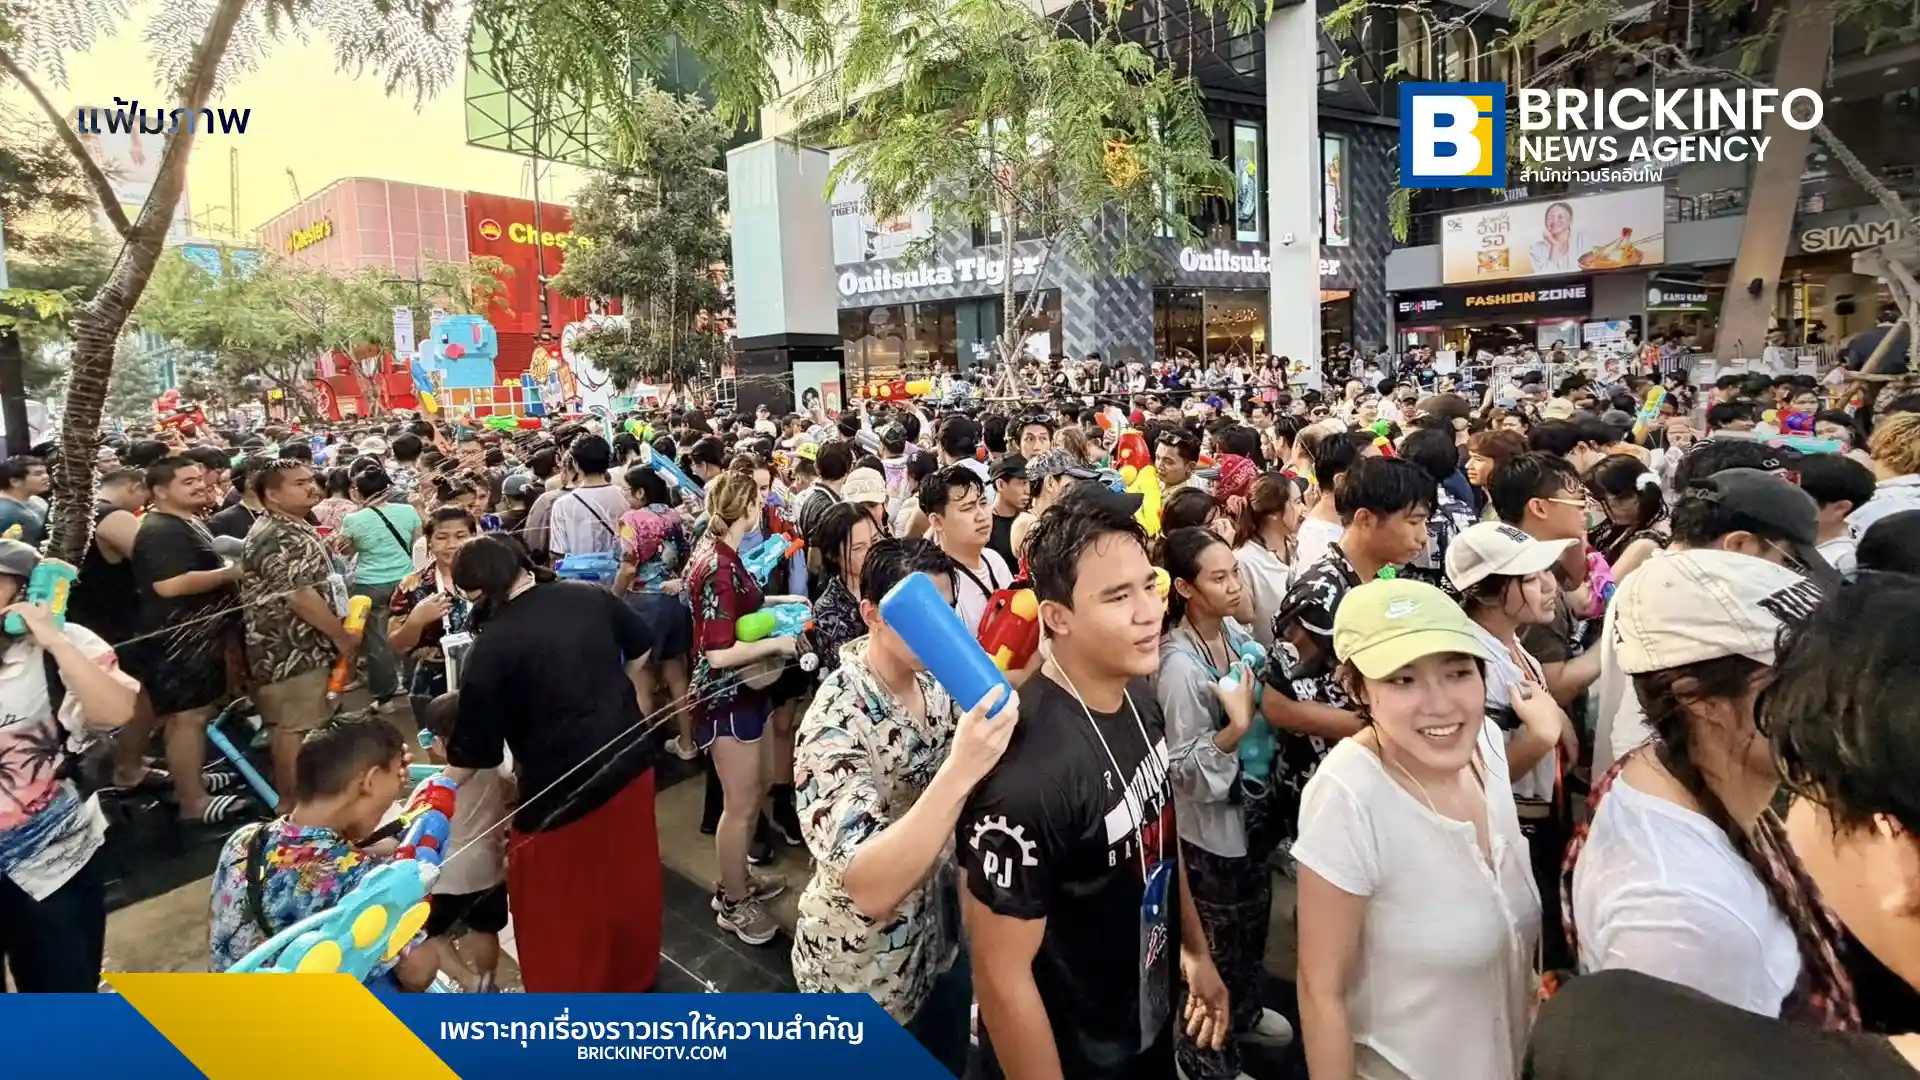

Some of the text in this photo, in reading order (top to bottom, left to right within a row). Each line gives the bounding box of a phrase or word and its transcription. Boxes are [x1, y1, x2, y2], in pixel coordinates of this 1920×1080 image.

[1802, 218, 1900, 252] SIAM
[838, 255, 1040, 296] Onitsuka Tiger
[1466, 286, 1587, 308] FASHION ZONE
